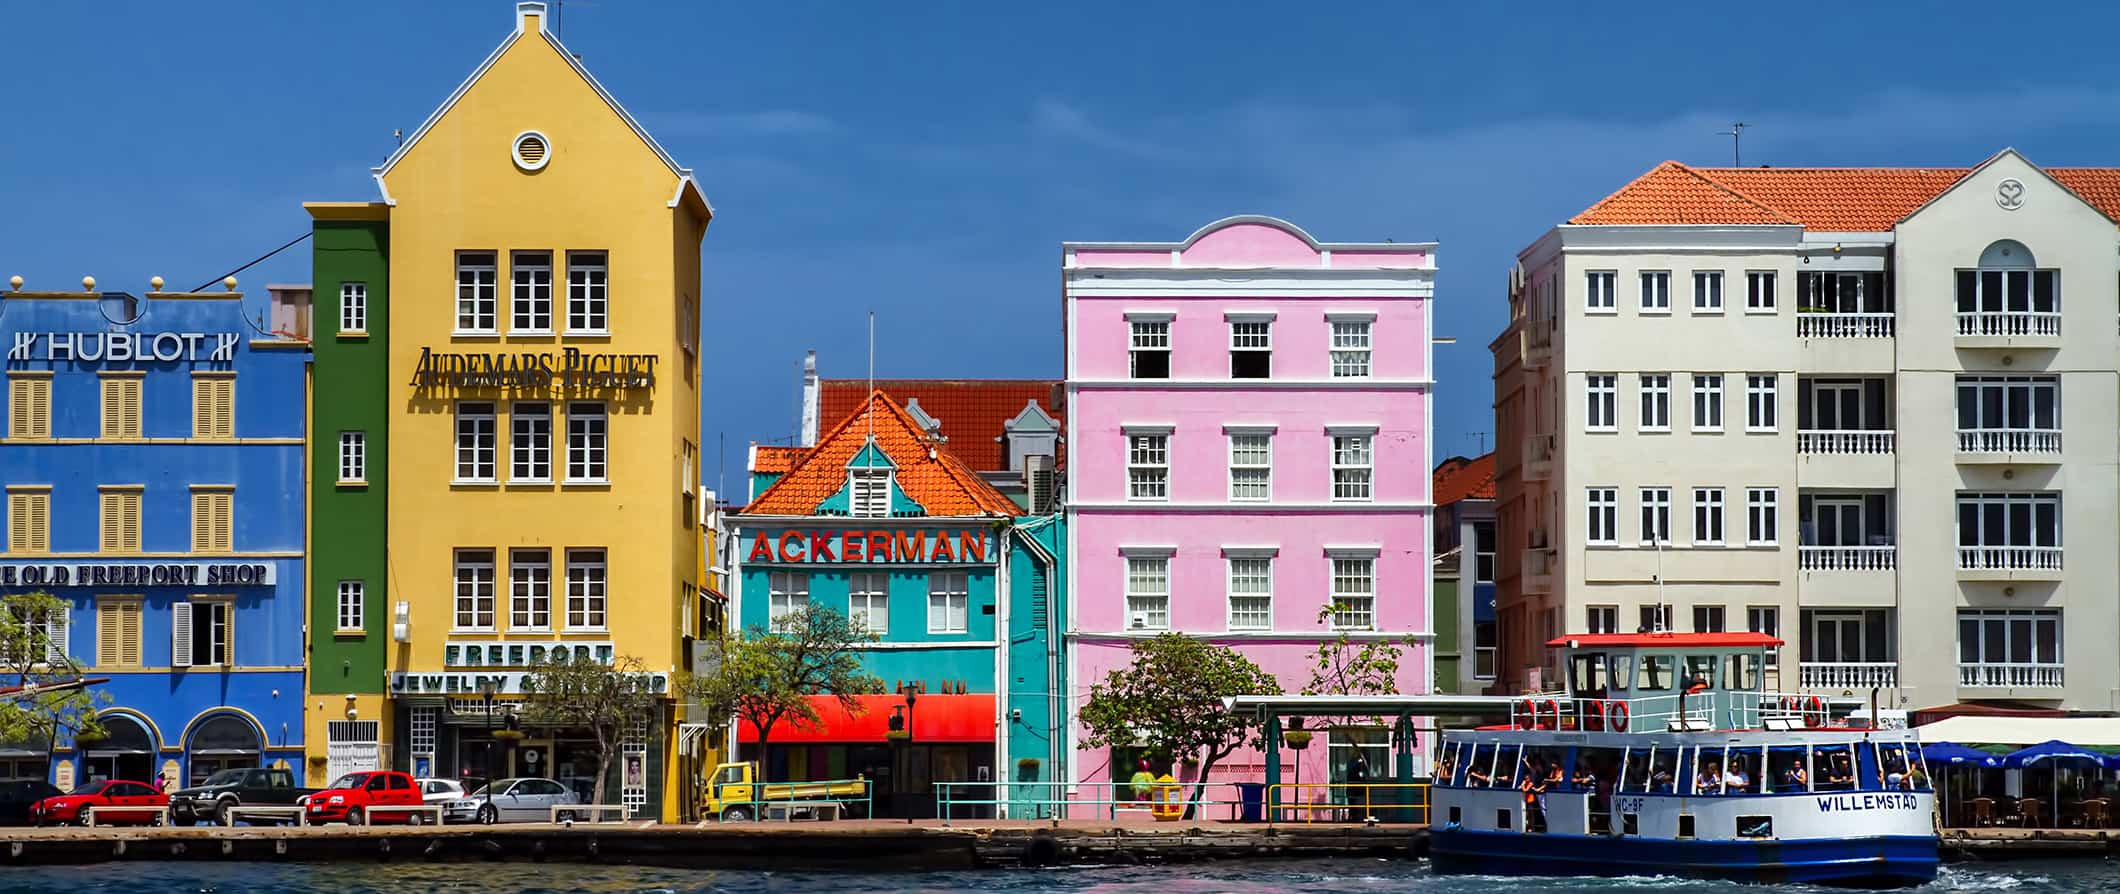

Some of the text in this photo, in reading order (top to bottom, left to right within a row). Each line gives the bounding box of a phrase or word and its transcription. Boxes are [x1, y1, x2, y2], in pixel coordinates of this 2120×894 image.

[48, 332, 205, 361] HUBLOT
[409, 346, 554, 387] AUDEMARS
[749, 529, 986, 562] ACKERMAN
[0, 563, 267, 585] E OLD FREEPORT SHOP
[445, 644, 612, 666] FREEPORT
[1816, 794, 1918, 812] WILLEMSTAD
